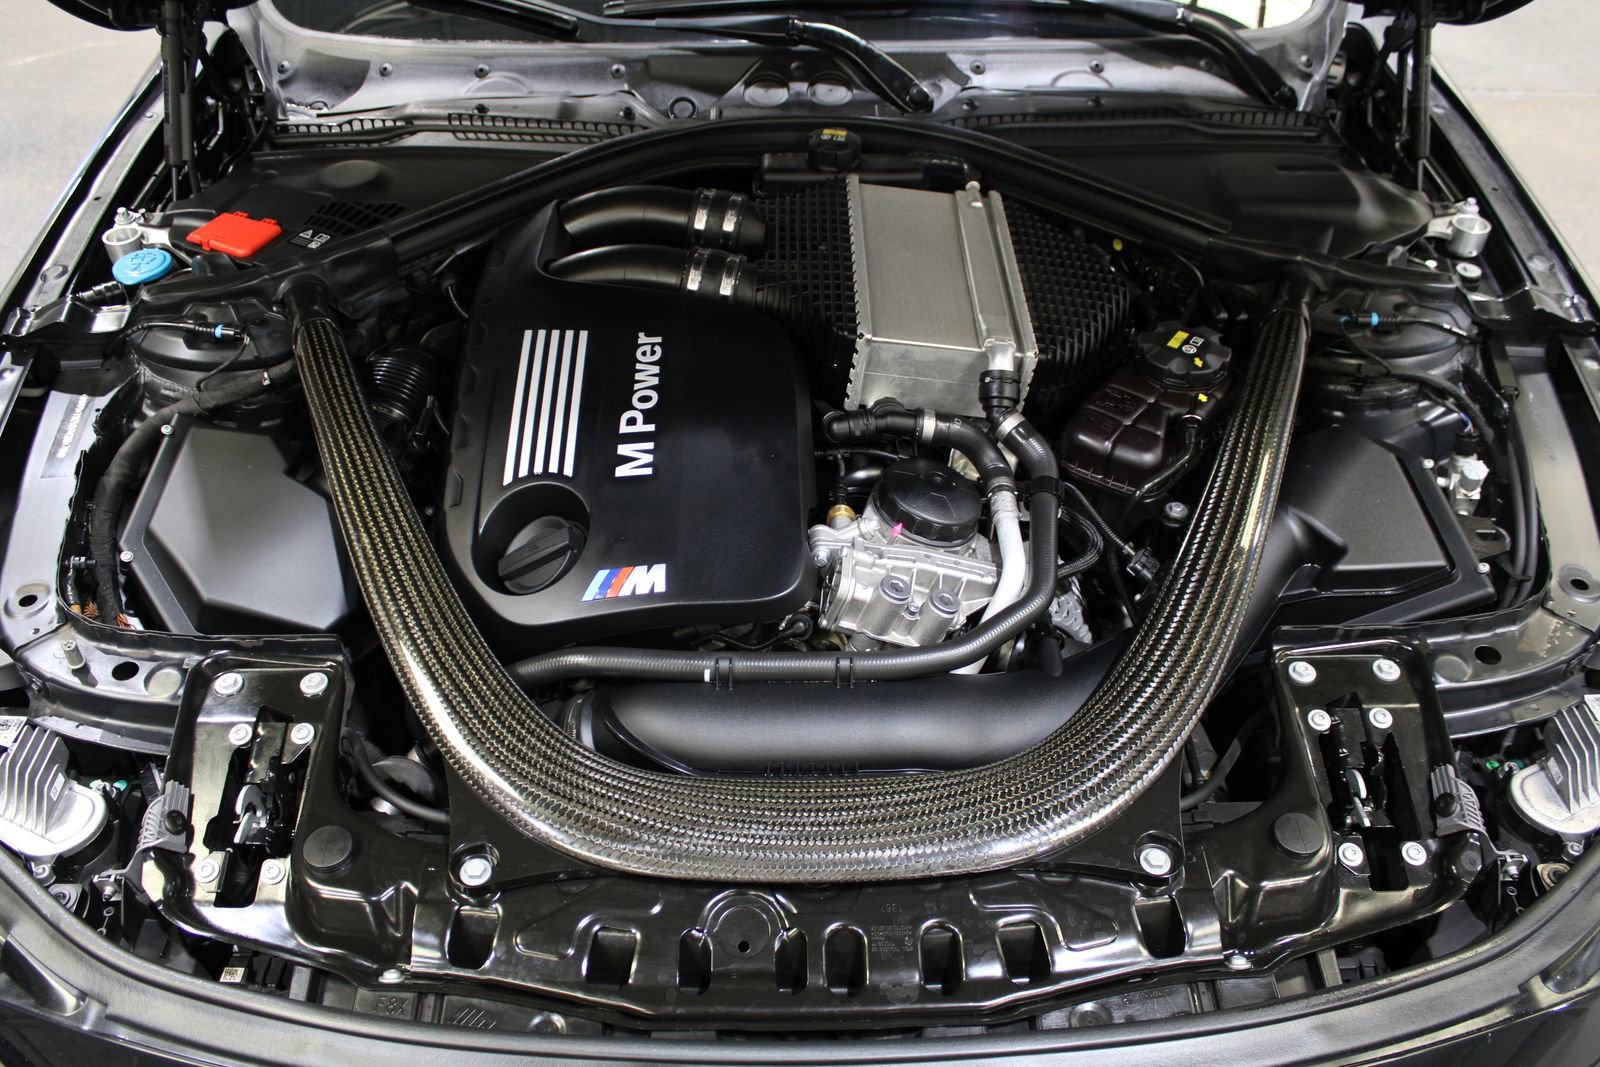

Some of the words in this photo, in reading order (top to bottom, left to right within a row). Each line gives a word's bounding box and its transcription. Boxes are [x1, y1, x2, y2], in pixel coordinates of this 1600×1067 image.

[619, 332, 662, 434] Power
[614, 442, 655, 478] M
[617, 563, 667, 597] M
